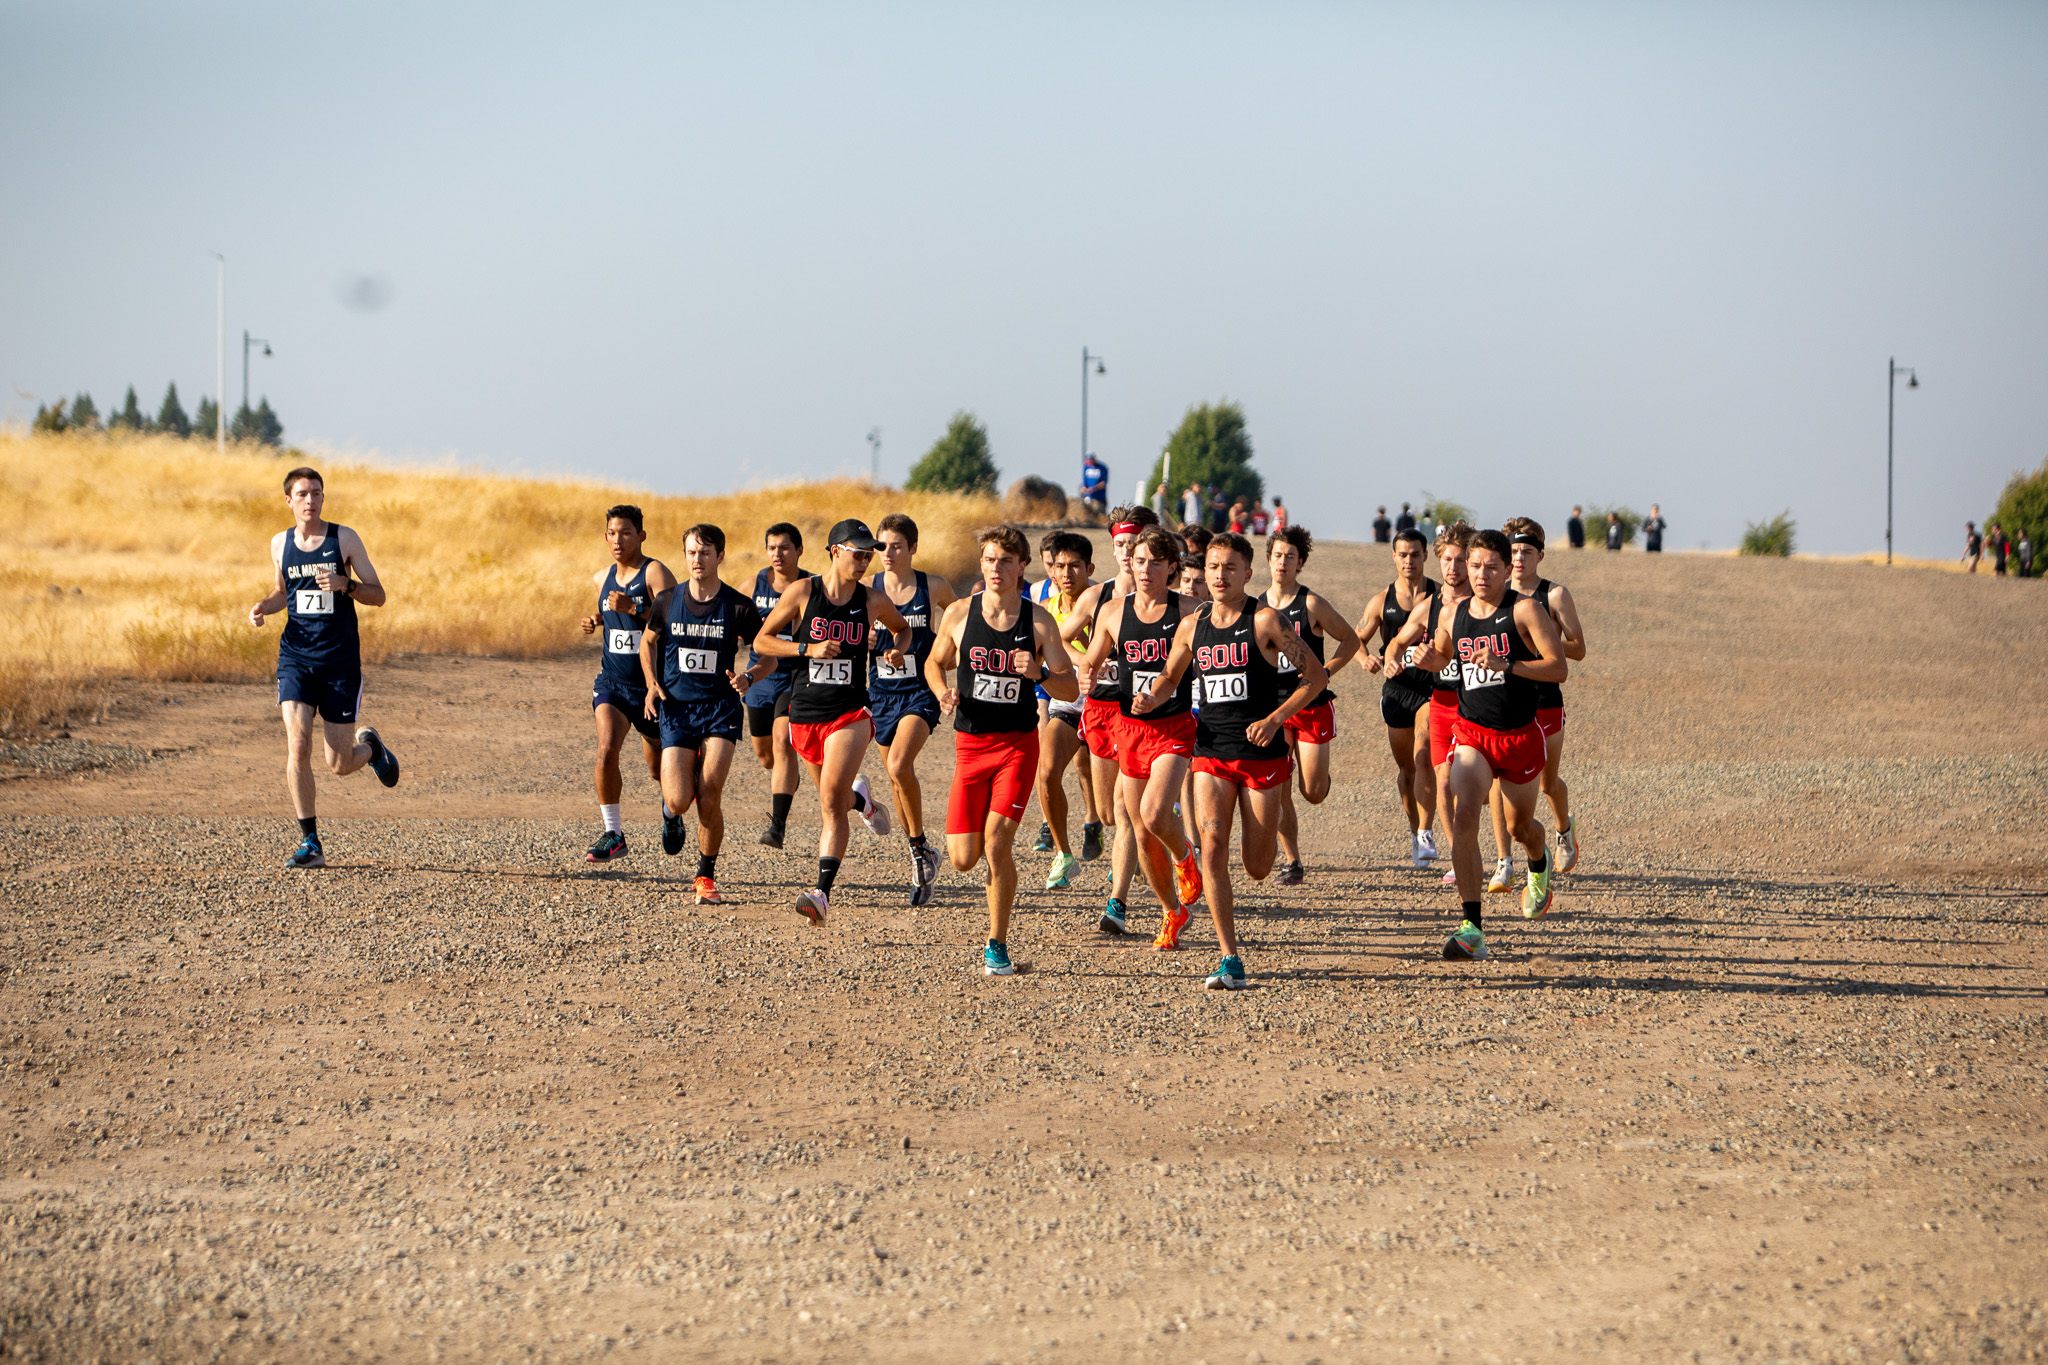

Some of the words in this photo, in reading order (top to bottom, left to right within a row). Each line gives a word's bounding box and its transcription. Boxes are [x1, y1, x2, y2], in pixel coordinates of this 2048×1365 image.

[287, 565, 302, 579] CAL
[305, 594, 325, 609] 71
[671, 622, 685, 635] CAL
[687, 623, 724, 638] MARITIME
[810, 616, 863, 645] SOU
[615, 634, 634, 650] 64
[685, 652, 707, 669] 61
[1197, 641, 1248, 671] SOU
[813, 661, 849, 681] 715
[978, 677, 1018, 700] 716
[1208, 677, 1244, 698] 710
